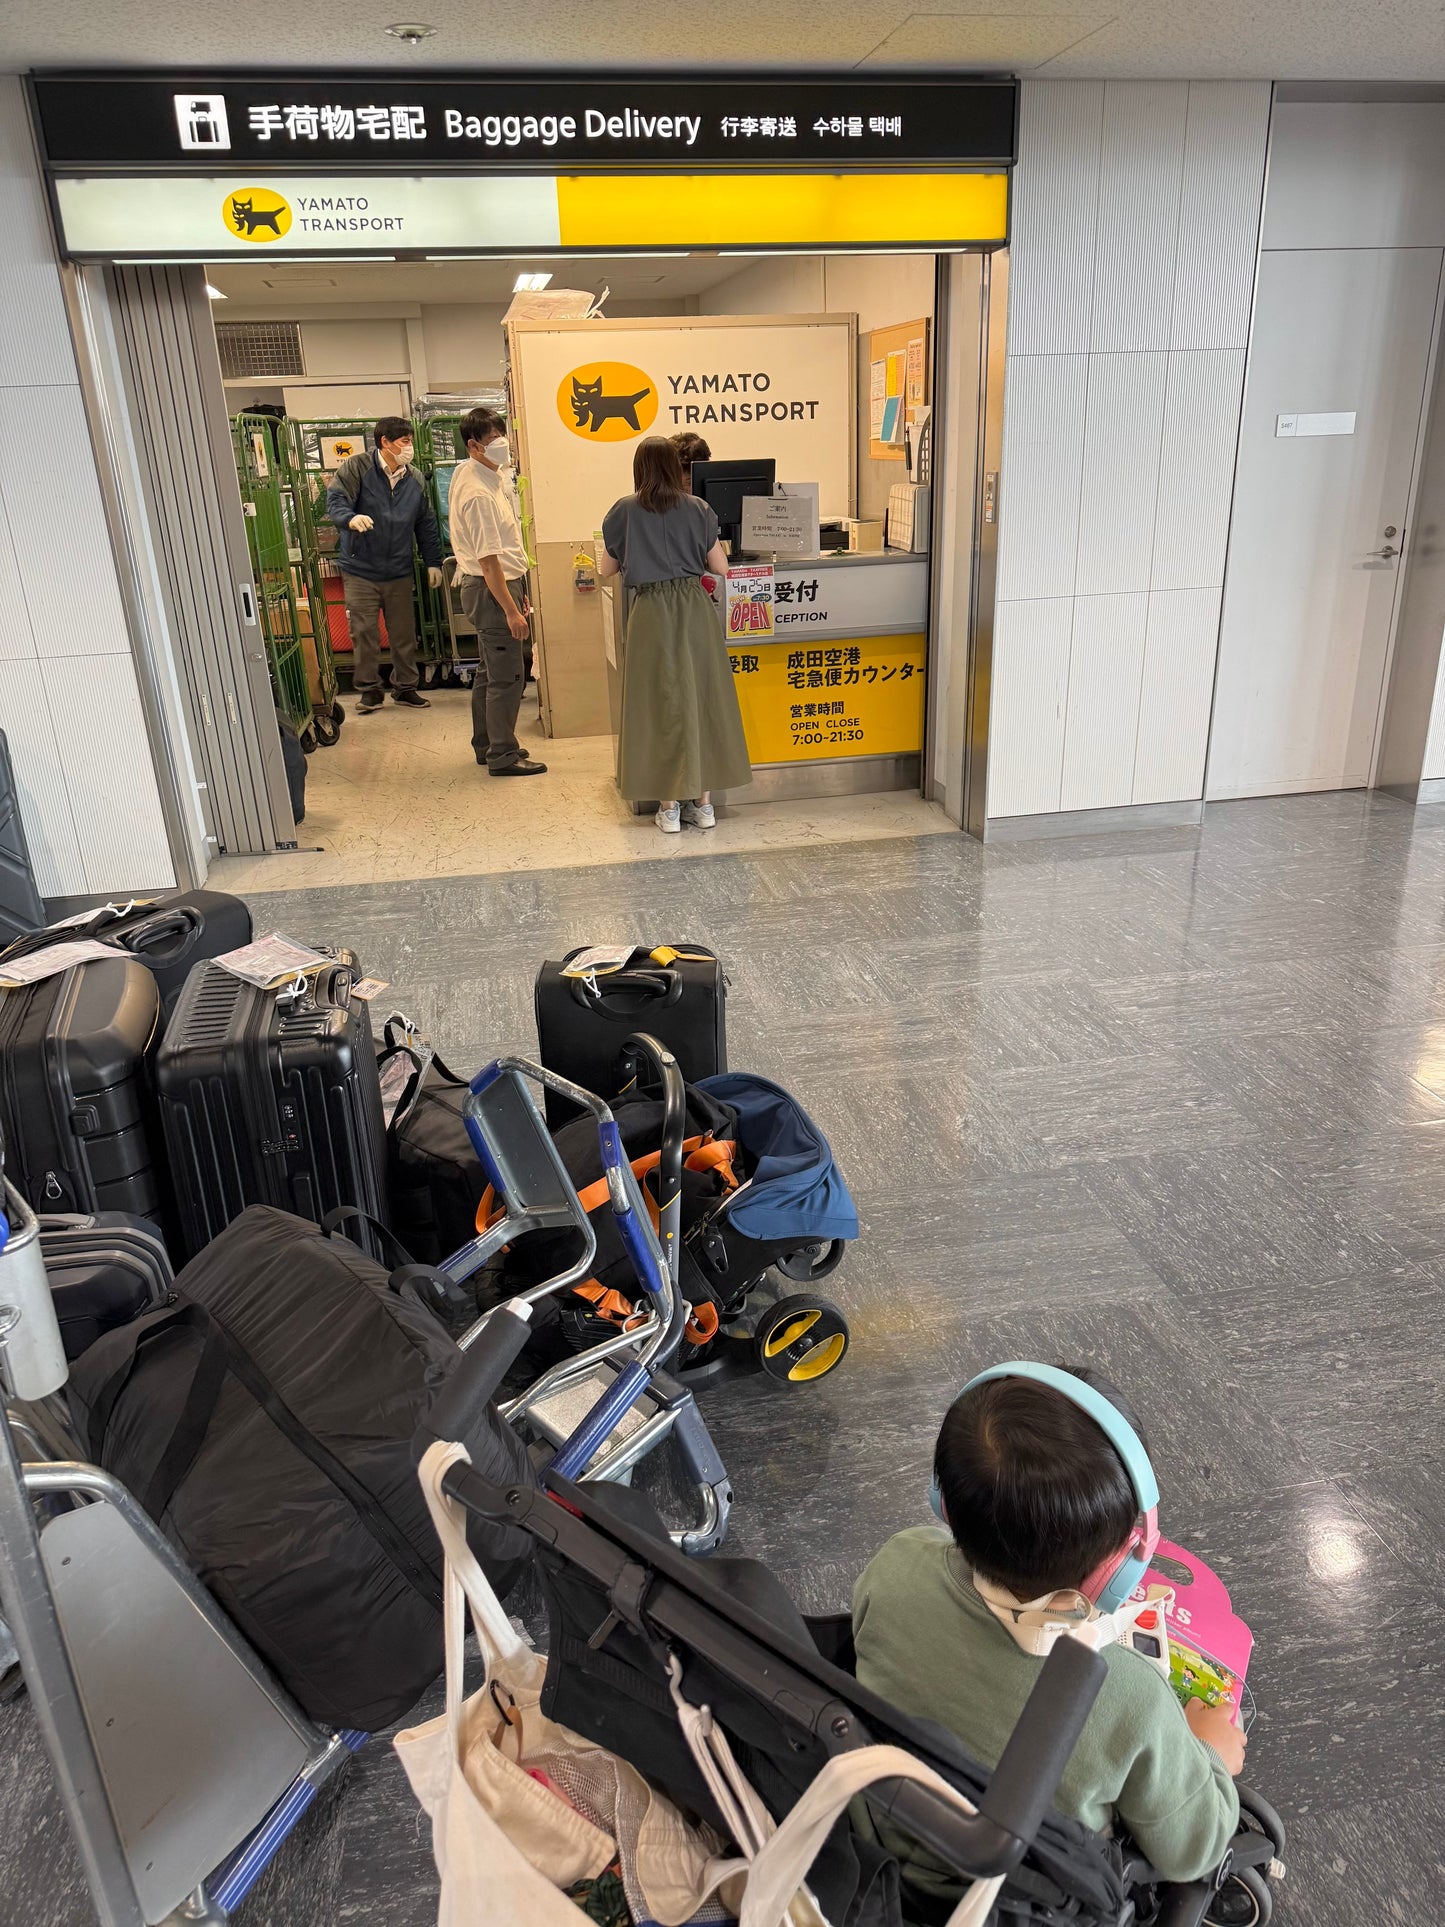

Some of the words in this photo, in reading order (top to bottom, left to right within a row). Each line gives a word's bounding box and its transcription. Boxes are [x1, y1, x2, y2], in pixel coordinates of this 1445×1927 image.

[247, 104, 427, 140] 手荷物宅配
[444, 109, 577, 146] Baggage
[584, 107, 702, 146] Delivery
[720, 115, 798, 138] 行李寄送
[812, 116, 864, 138] 수하물
[868, 115, 903, 138] 택배
[298, 197, 369, 211] YAMATO
[300, 217, 404, 232] TRANSPORT
[667, 372, 771, 395] YAMATO
[668, 400, 820, 425] TRANSPORT
[774, 579, 819, 604] 受付
[730, 601, 771, 632] OPEN
[775, 611, 828, 624] CEPTION
[787, 646, 861, 669] 成田空港
[787, 662, 924, 689] 宅急便カウンター
[790, 701, 845, 719] 営業時間
[790, 721, 820, 731] OPEN
[825, 717, 860, 728] CLOSE
